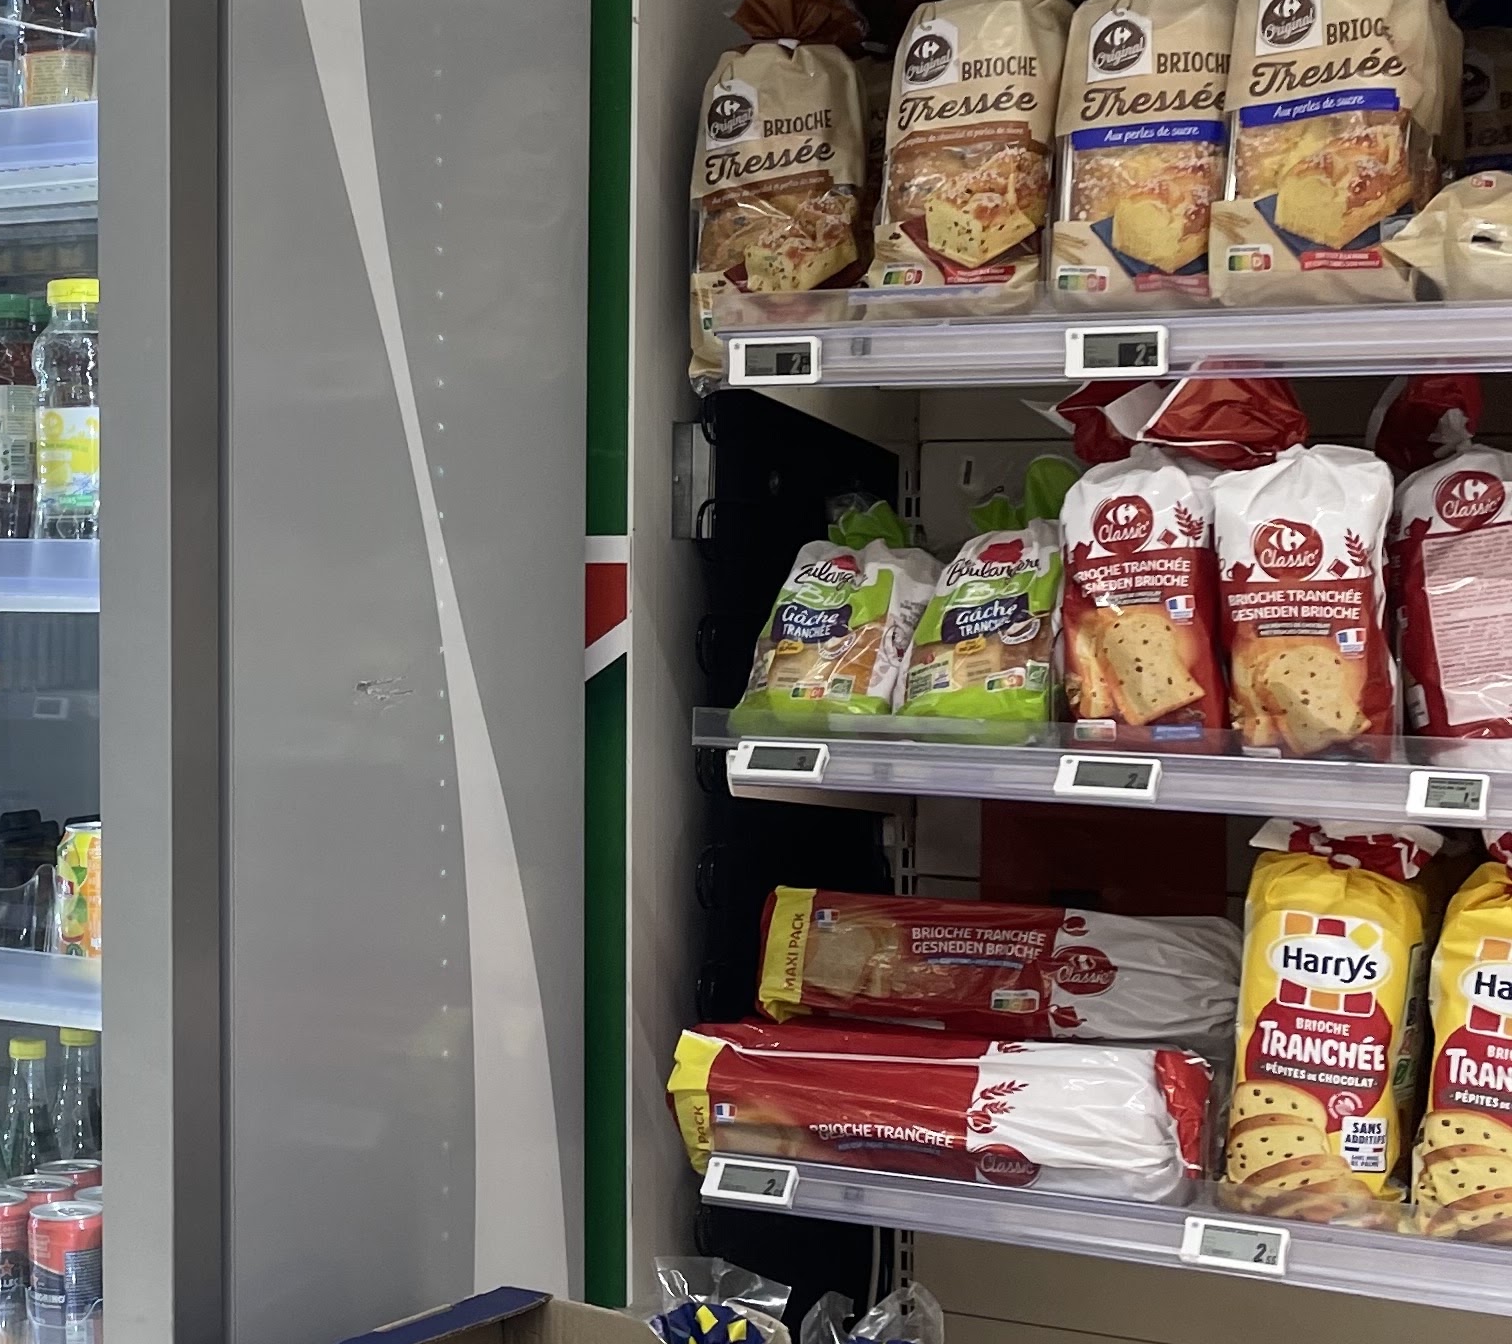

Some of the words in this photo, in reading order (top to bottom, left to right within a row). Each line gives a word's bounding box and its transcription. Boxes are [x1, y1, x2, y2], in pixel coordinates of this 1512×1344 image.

[962, 56, 1037, 82] BRIOCHE
[1249, 47, 1408, 97] Tressée
[898, 84, 1039, 130] Tressée
[763, 109, 833, 138] BRIOCHE
[705, 138, 836, 185] Tressée
[1122, 557, 1191, 576] TRANCHÉE
[1135, 574, 1190, 590] BRIOCHE
[1228, 590, 1285, 606] BRIOCHE
[1287, 588, 1362, 605] TRANCHÉE
[781, 605, 840, 627] Gâche
[1300, 605, 1360, 621] BRIOCHE
[789, 912, 805, 955] PACK
[912, 926, 972, 941] BRIOCHE
[974, 926, 1047, 946] TRANCHÉE
[912, 940, 985, 956] GESNEDEN
[785, 956, 803, 991] MAXI
[1282, 945, 1378, 984] Harrys
[1295, 1017, 1351, 1037] BRIOCHE
[1259, 1019, 1386, 1072] TRANCHÉE
[1352, 1121, 1383, 1135] SANS
